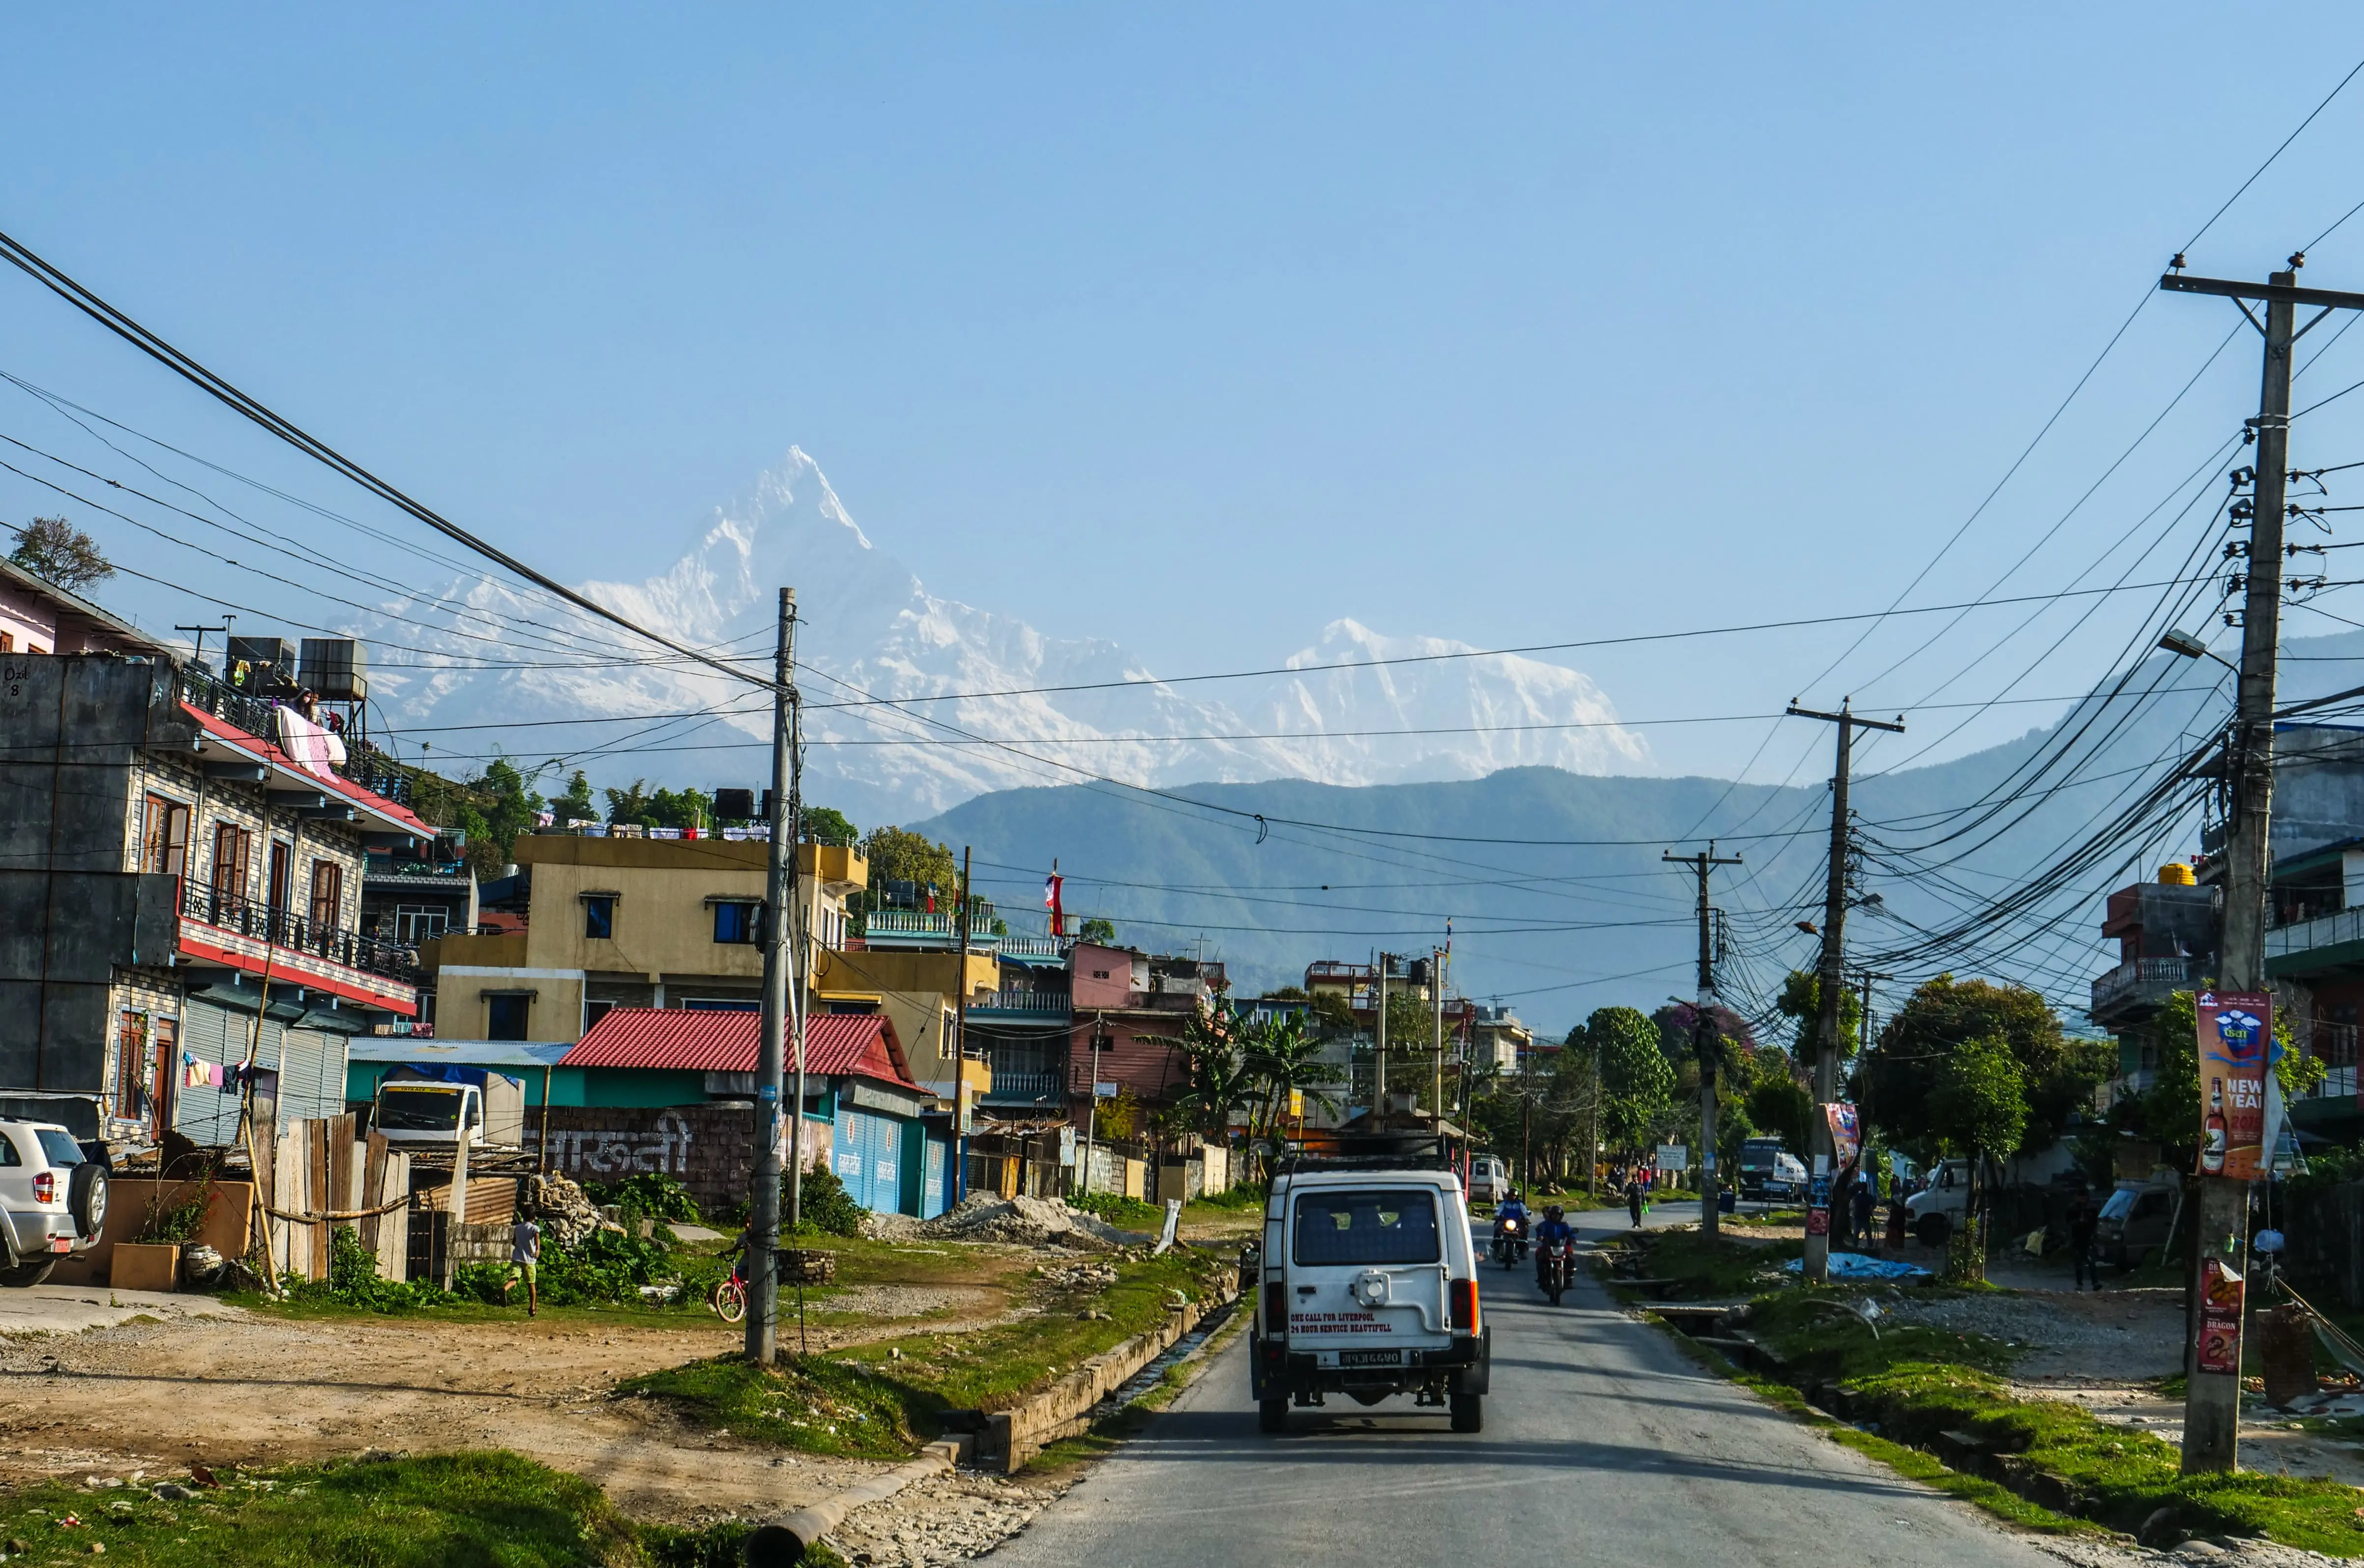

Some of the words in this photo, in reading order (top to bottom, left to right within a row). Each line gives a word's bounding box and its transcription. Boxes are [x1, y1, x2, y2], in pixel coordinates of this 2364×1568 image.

[4, 666, 28, 680] Ozil
[11, 684, 19, 696] 8
[2227, 1078, 2262, 1094] NEW
[1291, 1313, 1304, 1322] ONE
[1305, 1313, 1322, 1322] CALL
[1323, 1313, 1336, 1322] FOR
[1338, 1313, 1375, 1321] LIVERPOOL
[1300, 1325, 1319, 1333] HOUR
[1320, 1324, 1348, 1333] SERVICE
[1350, 1324, 1392, 1332] BEAUTIFULL
[2207, 1321, 2236, 1331] DRAGON
